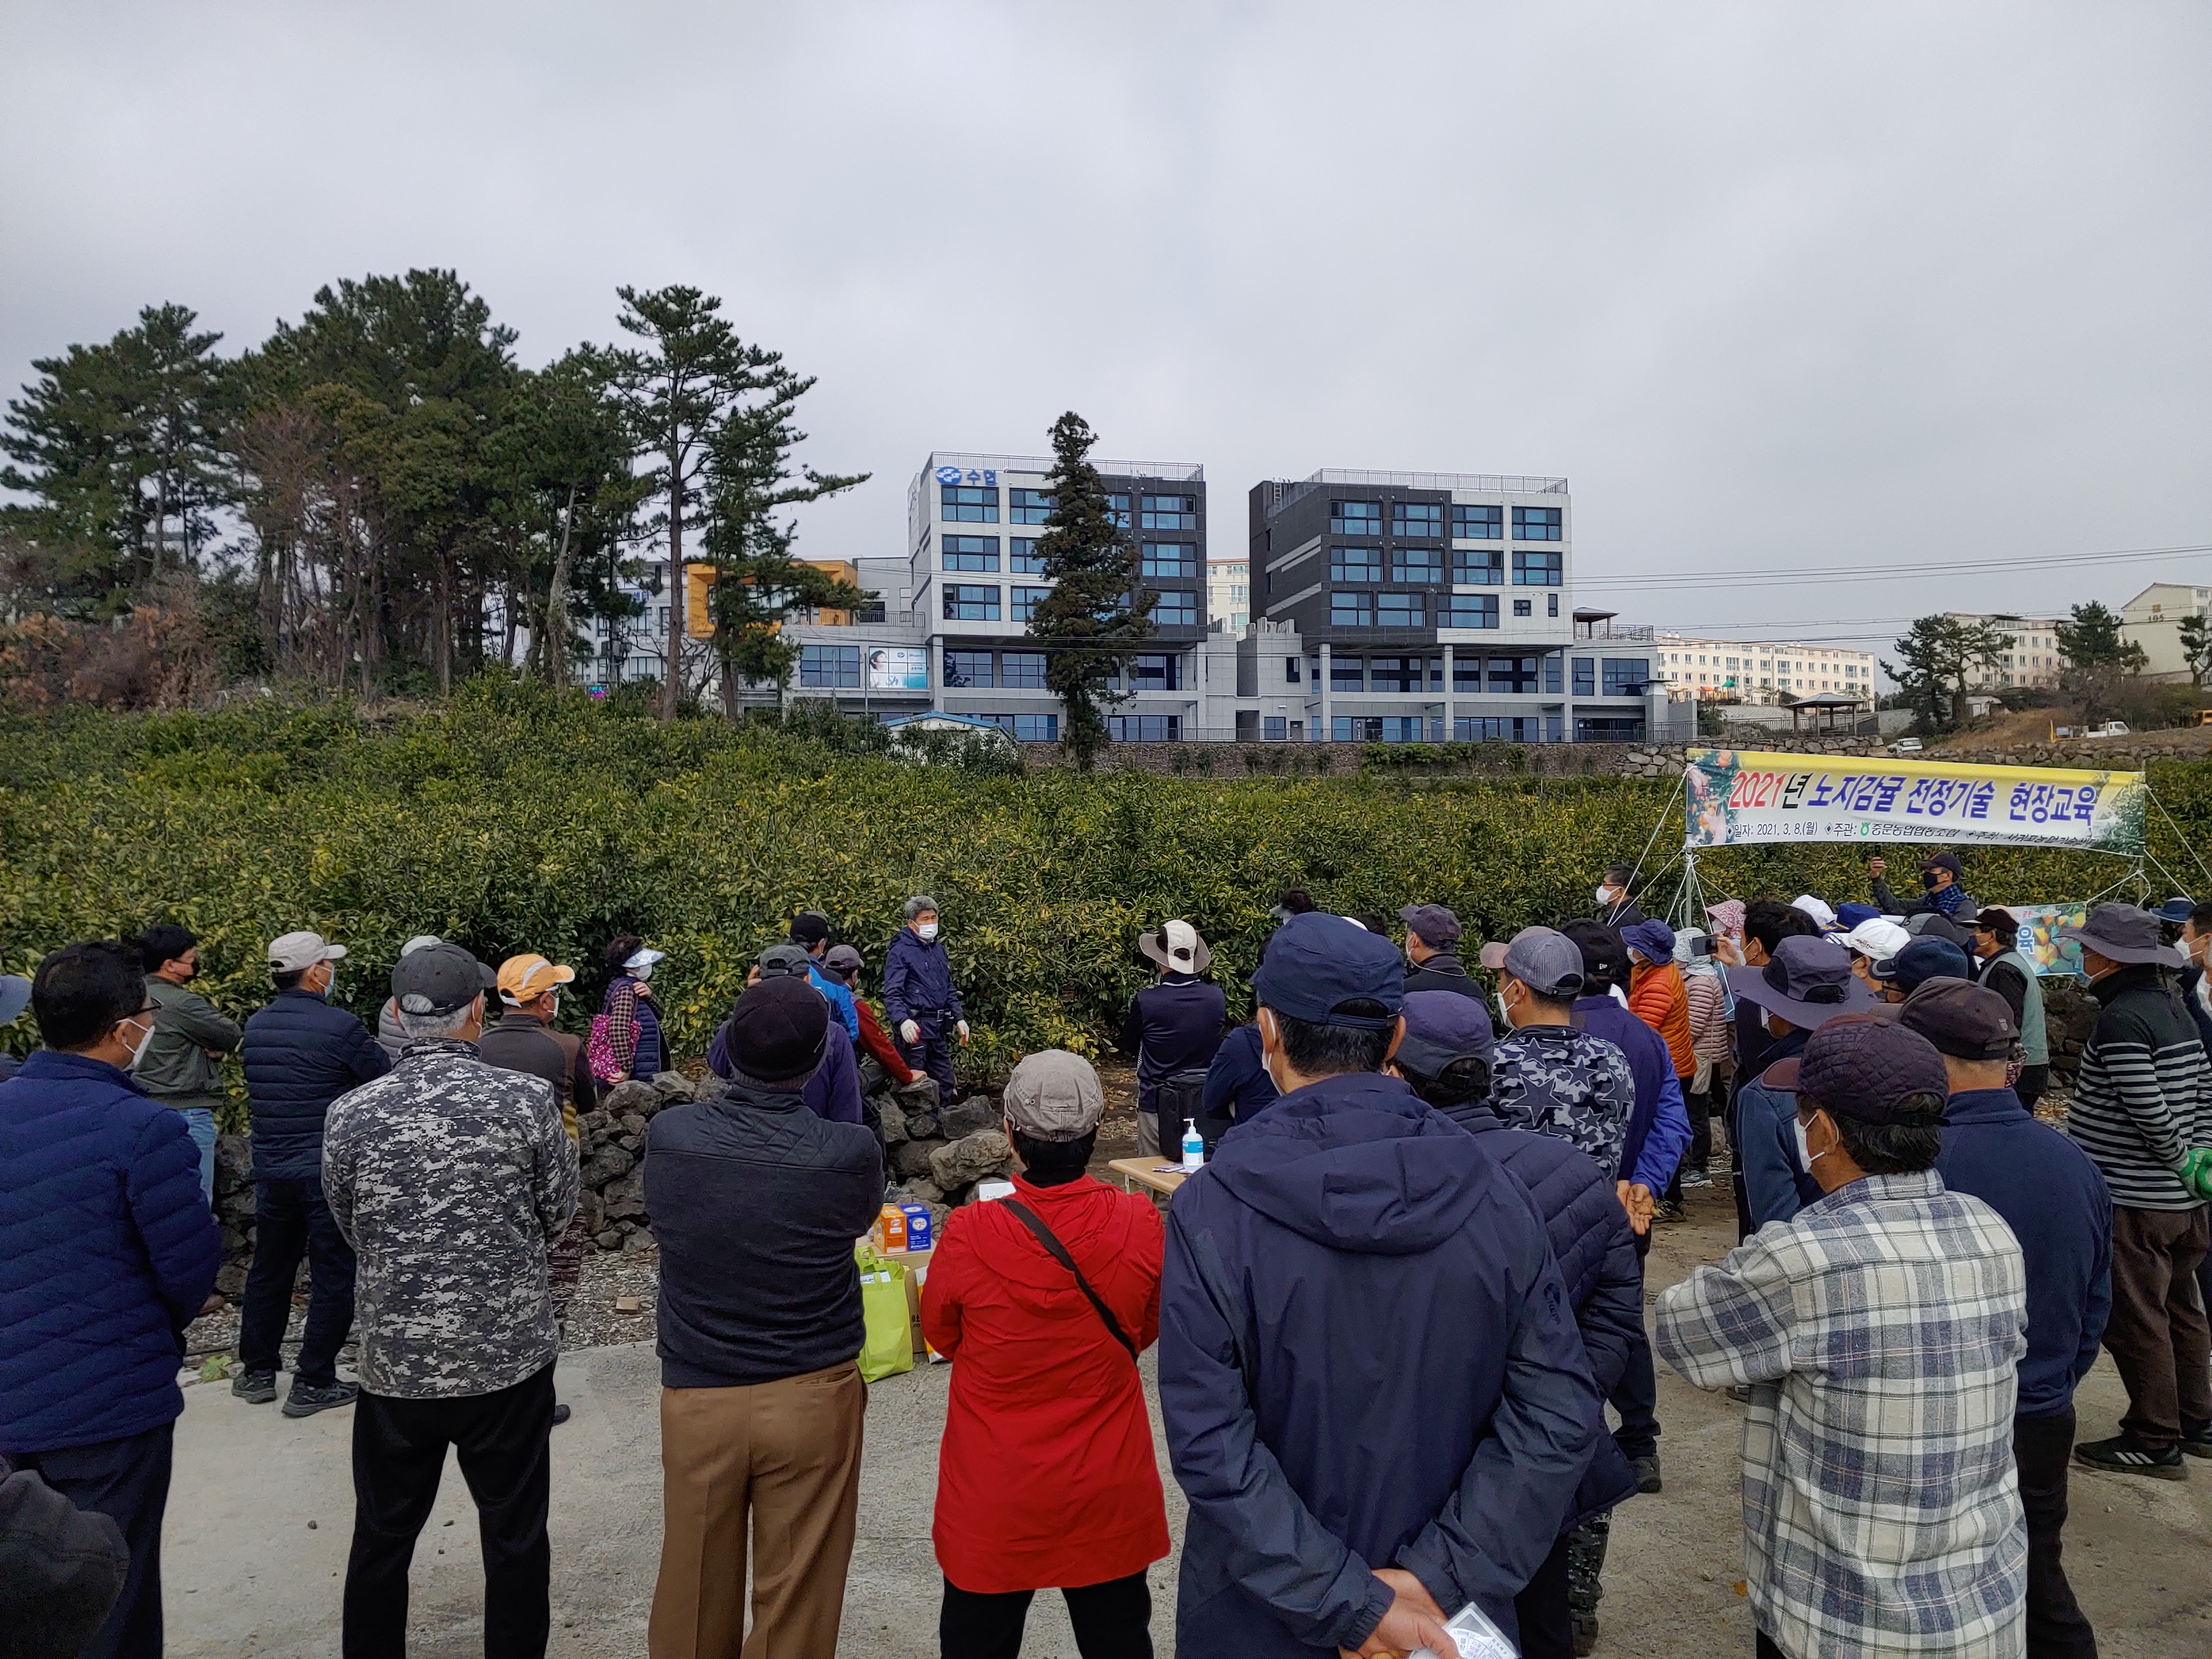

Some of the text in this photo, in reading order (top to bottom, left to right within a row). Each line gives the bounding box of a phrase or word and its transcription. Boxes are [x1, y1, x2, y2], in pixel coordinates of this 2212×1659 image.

[966, 469, 996, 486] 수협
[1729, 771, 2097, 827] 2021년 노지감귤 전정기술 현장교육
[1734, 823, 1754, 838] 일자:
[1833, 823, 1857, 837] 주관:
[2019, 926, 2034, 954] 육
